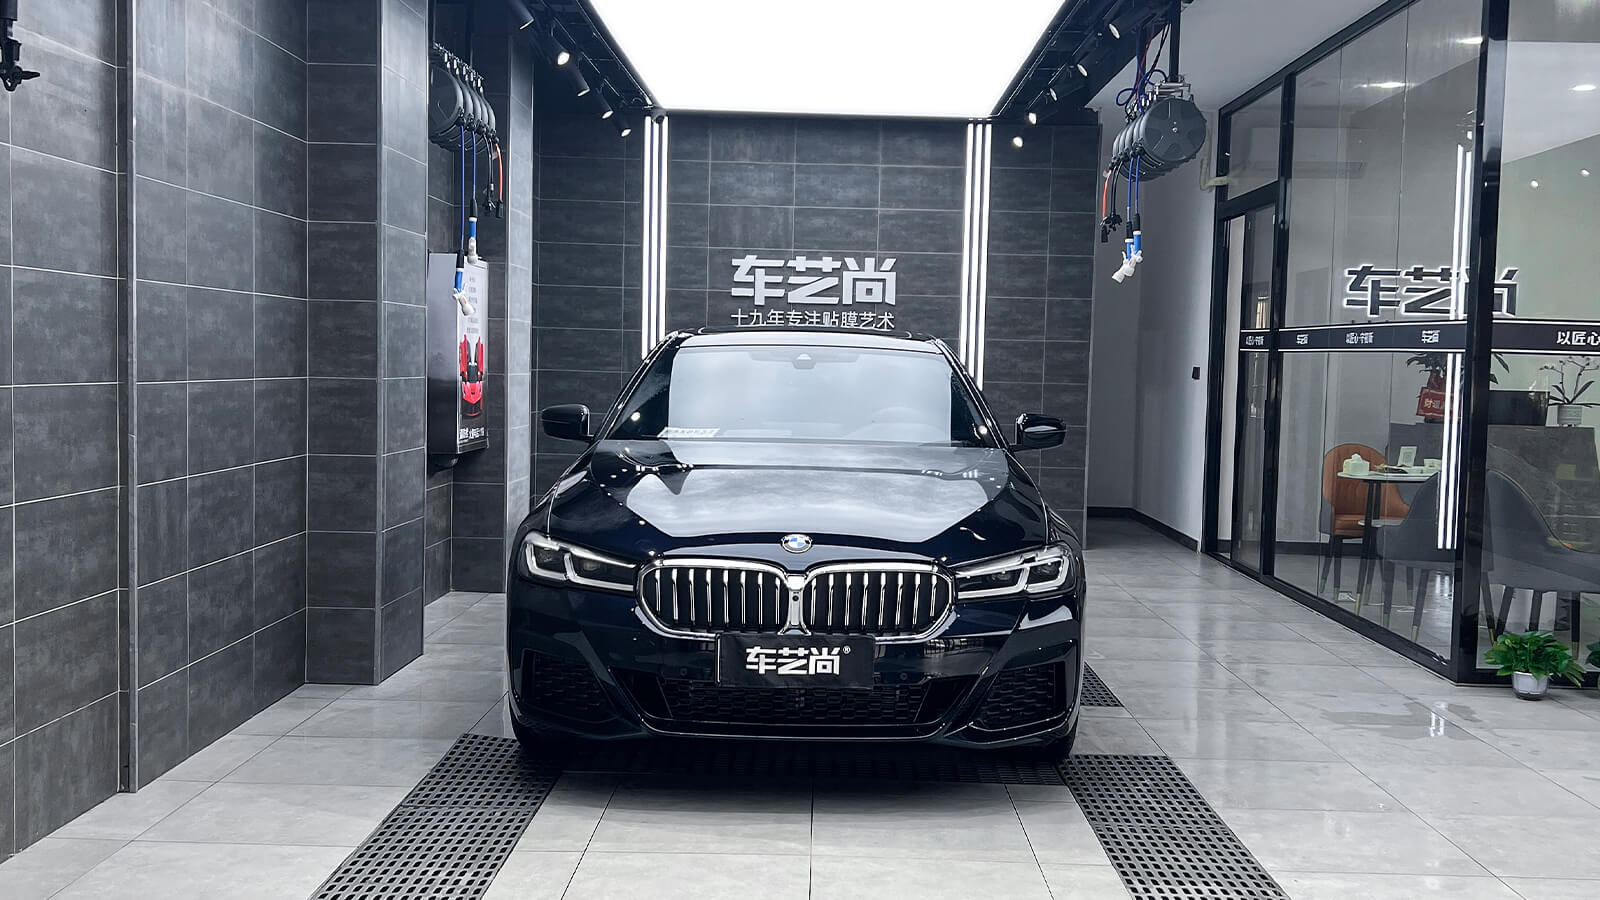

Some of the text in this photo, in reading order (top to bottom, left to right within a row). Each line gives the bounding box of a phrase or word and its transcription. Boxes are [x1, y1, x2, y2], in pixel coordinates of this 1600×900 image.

[731, 255, 896, 305] 车艺尚
[731, 308, 895, 331] 十九年专注贴膜艺术
[1556, 331, 1600, 346] 以匠心
